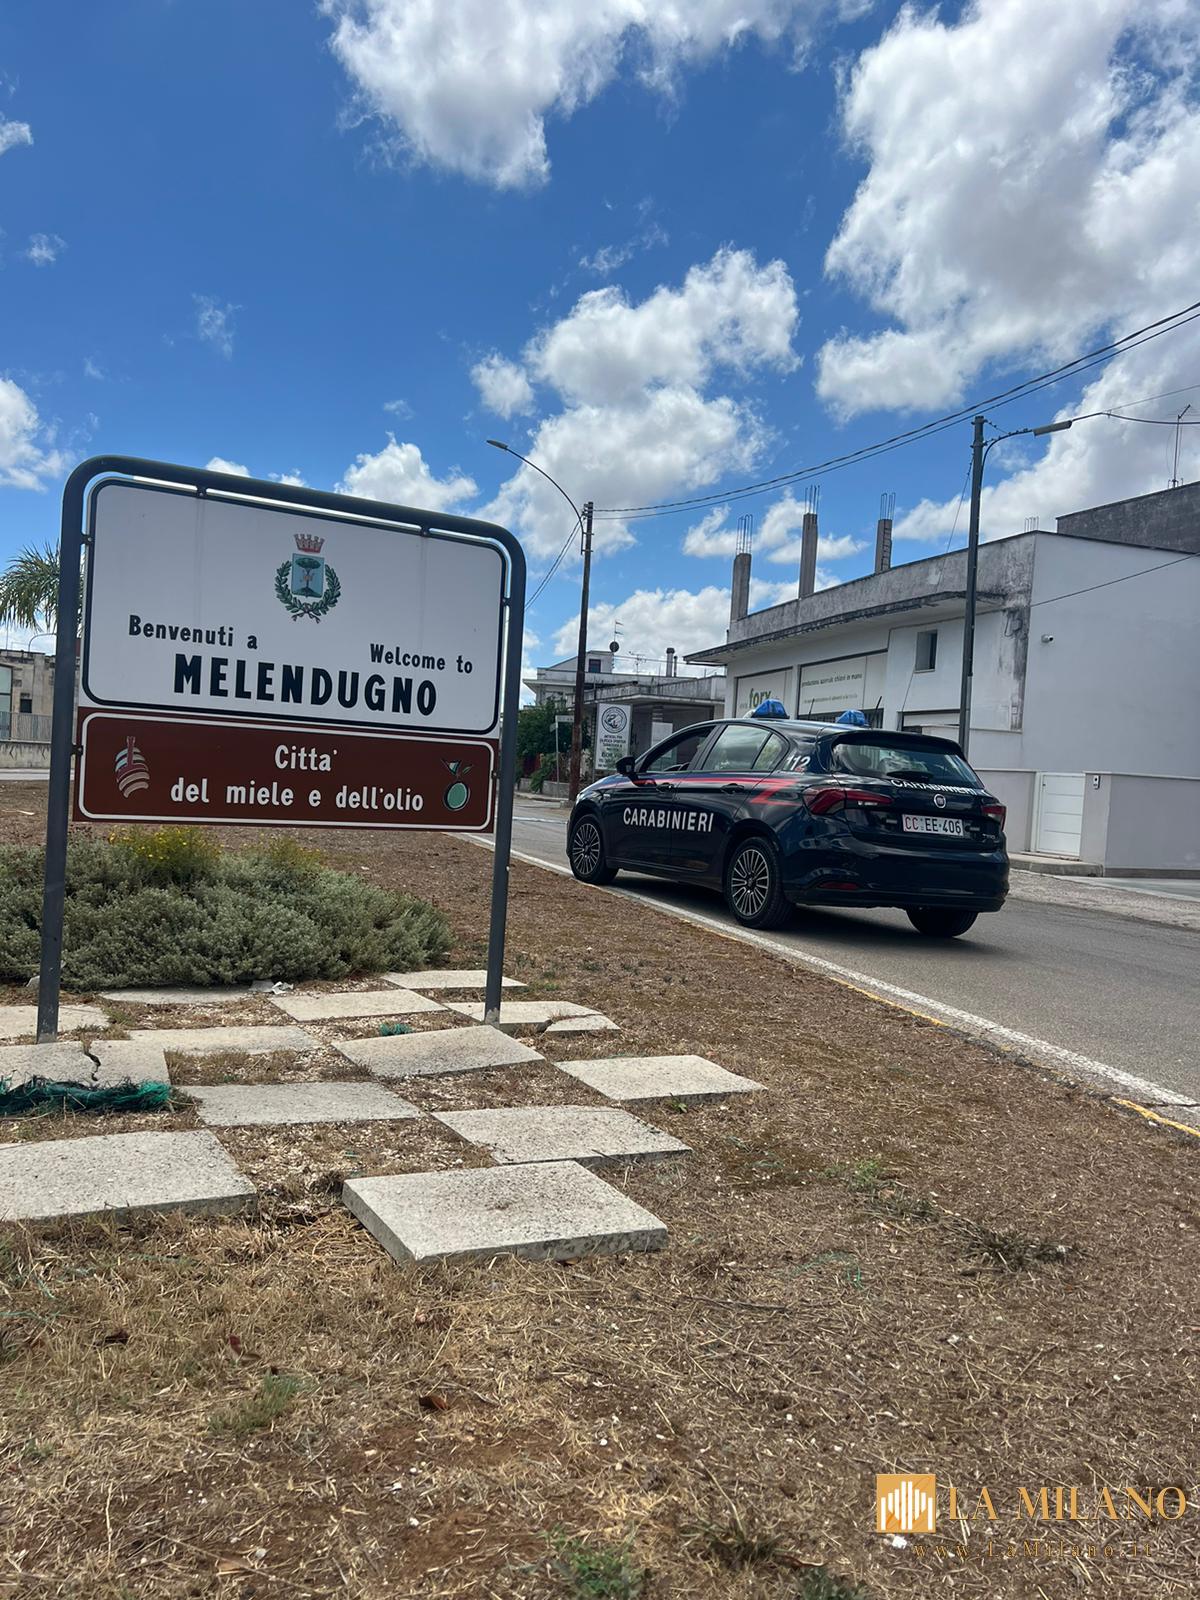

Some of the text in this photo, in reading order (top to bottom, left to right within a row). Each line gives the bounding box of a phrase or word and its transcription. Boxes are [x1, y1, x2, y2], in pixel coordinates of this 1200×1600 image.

[129, 615, 258, 650] Benvenuti a
[370, 643, 473, 674] Welcome to
[174, 653, 436, 716] MELENDUGNO
[274, 744, 338, 772] Citta'
[787, 754, 811, 771] 112
[170, 777, 424, 812] del miele e dell'olio
[890, 780, 977, 796] CARABINIERI
[623, 807, 714, 833] CARABINIERI
[905, 816, 962, 834] CC EE 406
